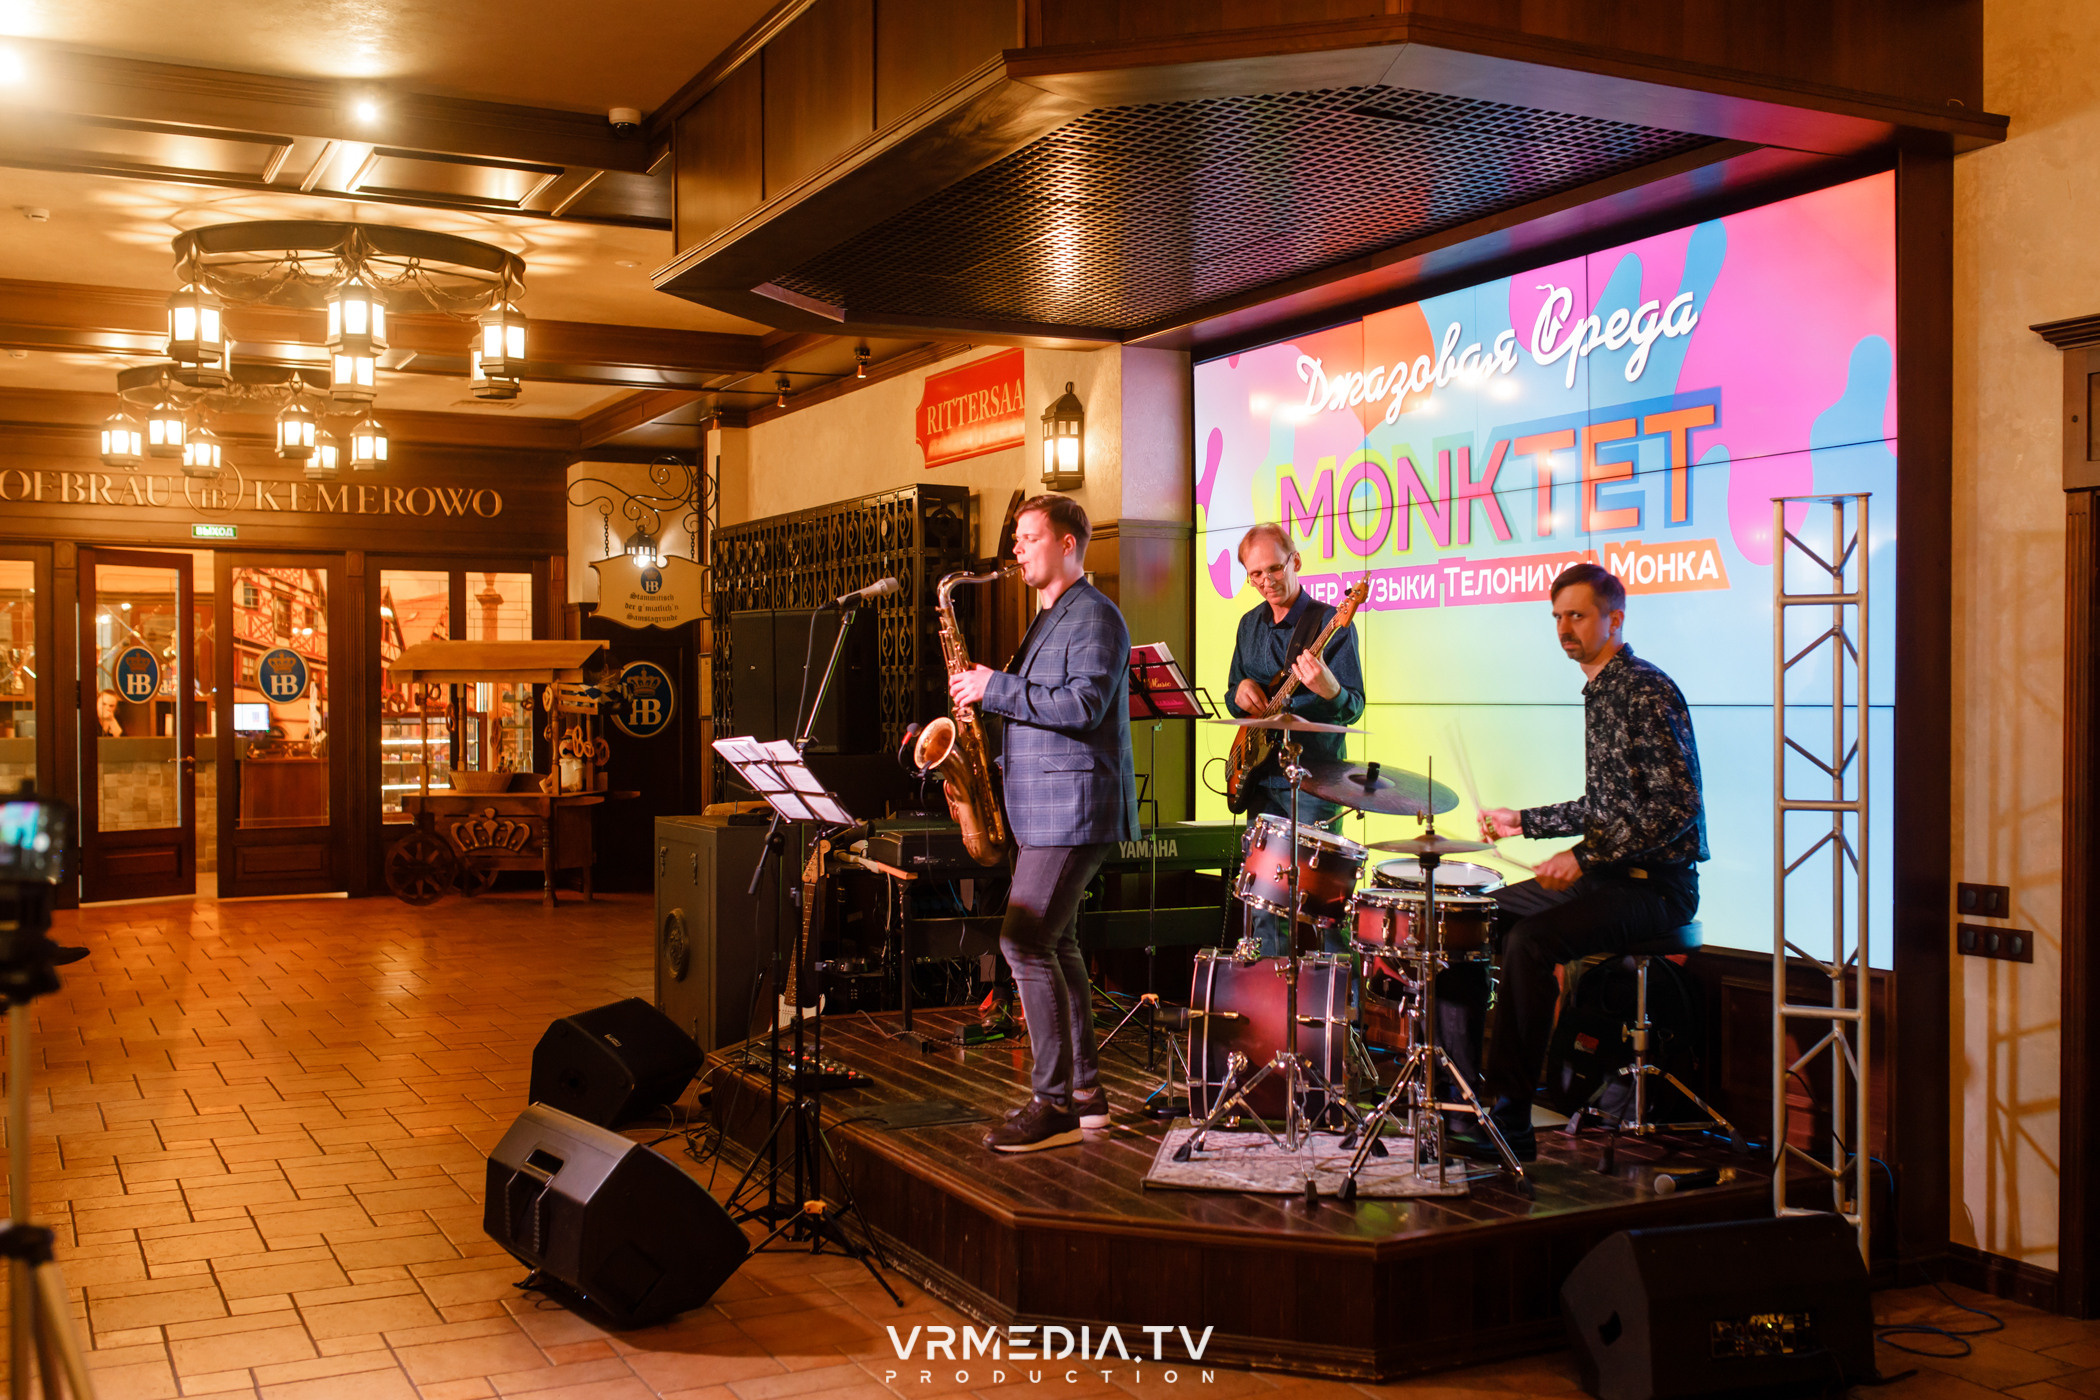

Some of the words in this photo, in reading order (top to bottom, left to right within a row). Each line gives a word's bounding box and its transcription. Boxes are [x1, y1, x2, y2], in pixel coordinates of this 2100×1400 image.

[1296, 321, 1518, 425] Джазовая
[1531, 283, 1699, 389] Среда
[927, 378, 1024, 435] RITTERSAA
[1279, 404, 1716, 560] MONKTET
[254, 480, 503, 518] KEMEROWO
[195, 526, 234, 537] ВЫХОД
[645, 580, 659, 592] HB
[1443, 559, 1594, 598] ТЕЛОНИУ
[1610, 549, 1719, 585] МОНКА
[126, 673, 152, 695] HB
[270, 673, 299, 696] HB
[628, 698, 662, 726] HB
